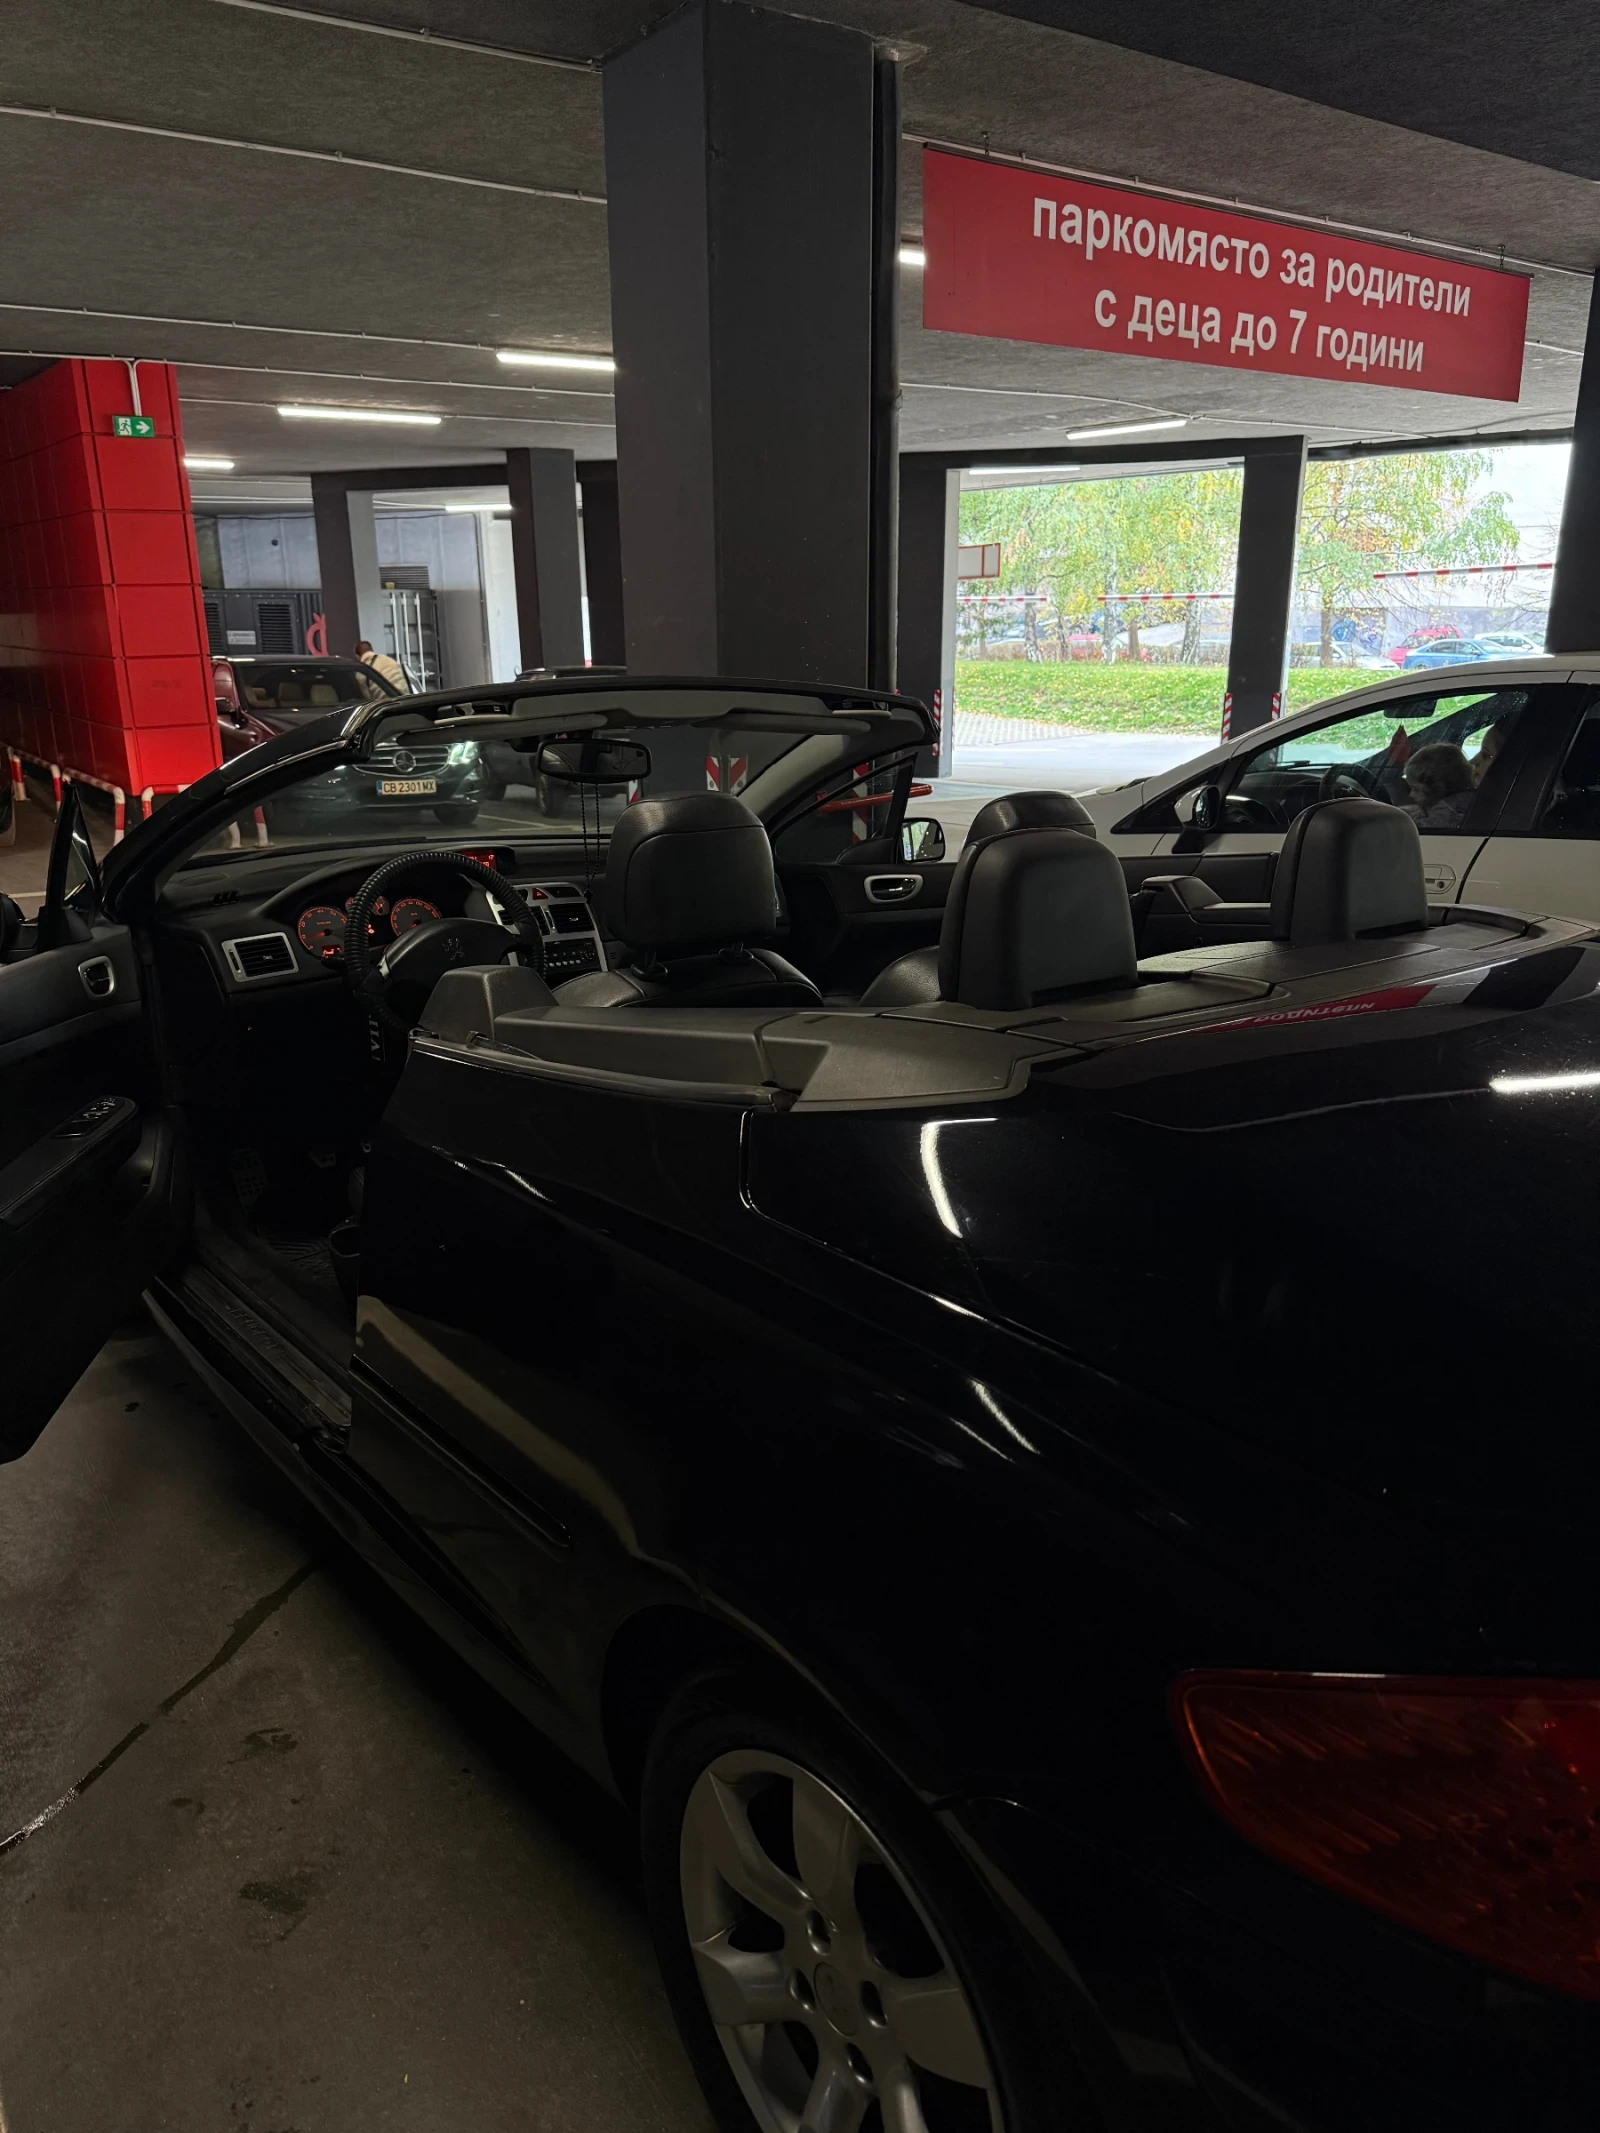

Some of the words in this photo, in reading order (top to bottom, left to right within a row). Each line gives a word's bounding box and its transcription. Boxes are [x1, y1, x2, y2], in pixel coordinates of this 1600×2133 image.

[1033, 197, 1270, 279] паркомясто
[1279, 248, 1316, 288] за
[1325, 257, 1471, 317] родители
[1094, 289, 1117, 328] с
[1127, 294, 1221, 349] деца
[1230, 311, 1277, 357] до
[1289, 308, 1308, 354] 7
[1316, 324, 1424, 373] години
